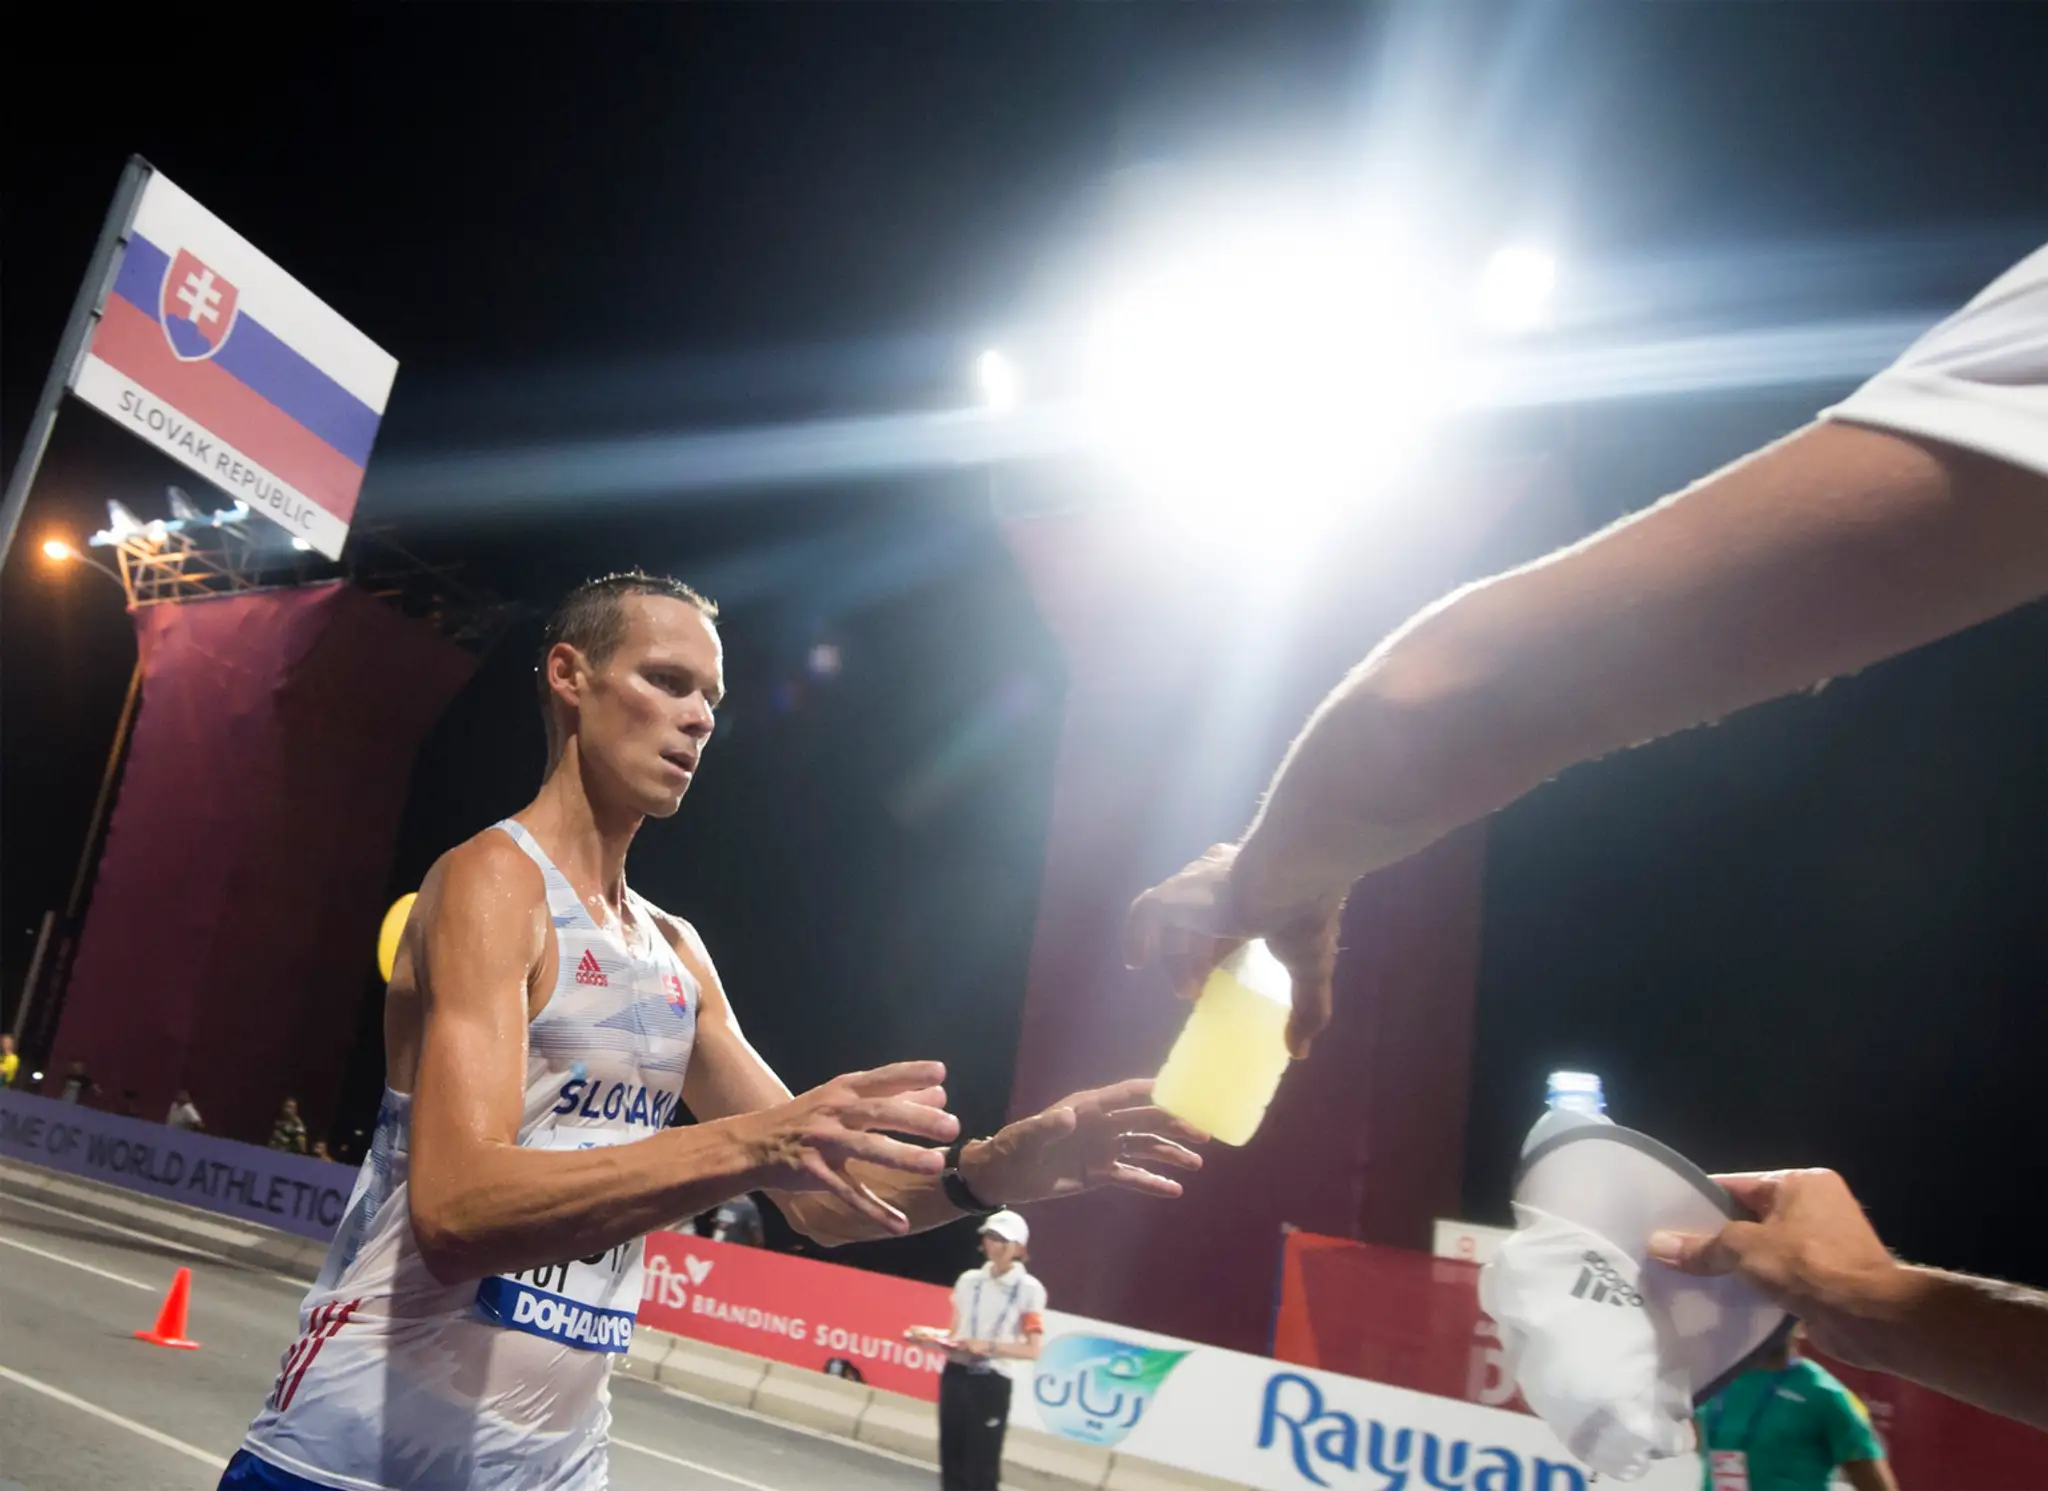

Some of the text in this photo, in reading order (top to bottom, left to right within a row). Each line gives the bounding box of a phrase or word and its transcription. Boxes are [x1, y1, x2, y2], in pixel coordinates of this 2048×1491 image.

[117, 390, 317, 531] SLOVAK REPUBLIC
[576, 970, 608, 988] adidas
[87, 1132, 185, 1187] WORLD
[187, 1158, 350, 1228] ATHLETIC
[691, 1293, 808, 1341] BRANDING
[1256, 1372, 1590, 1491] Rayyan
